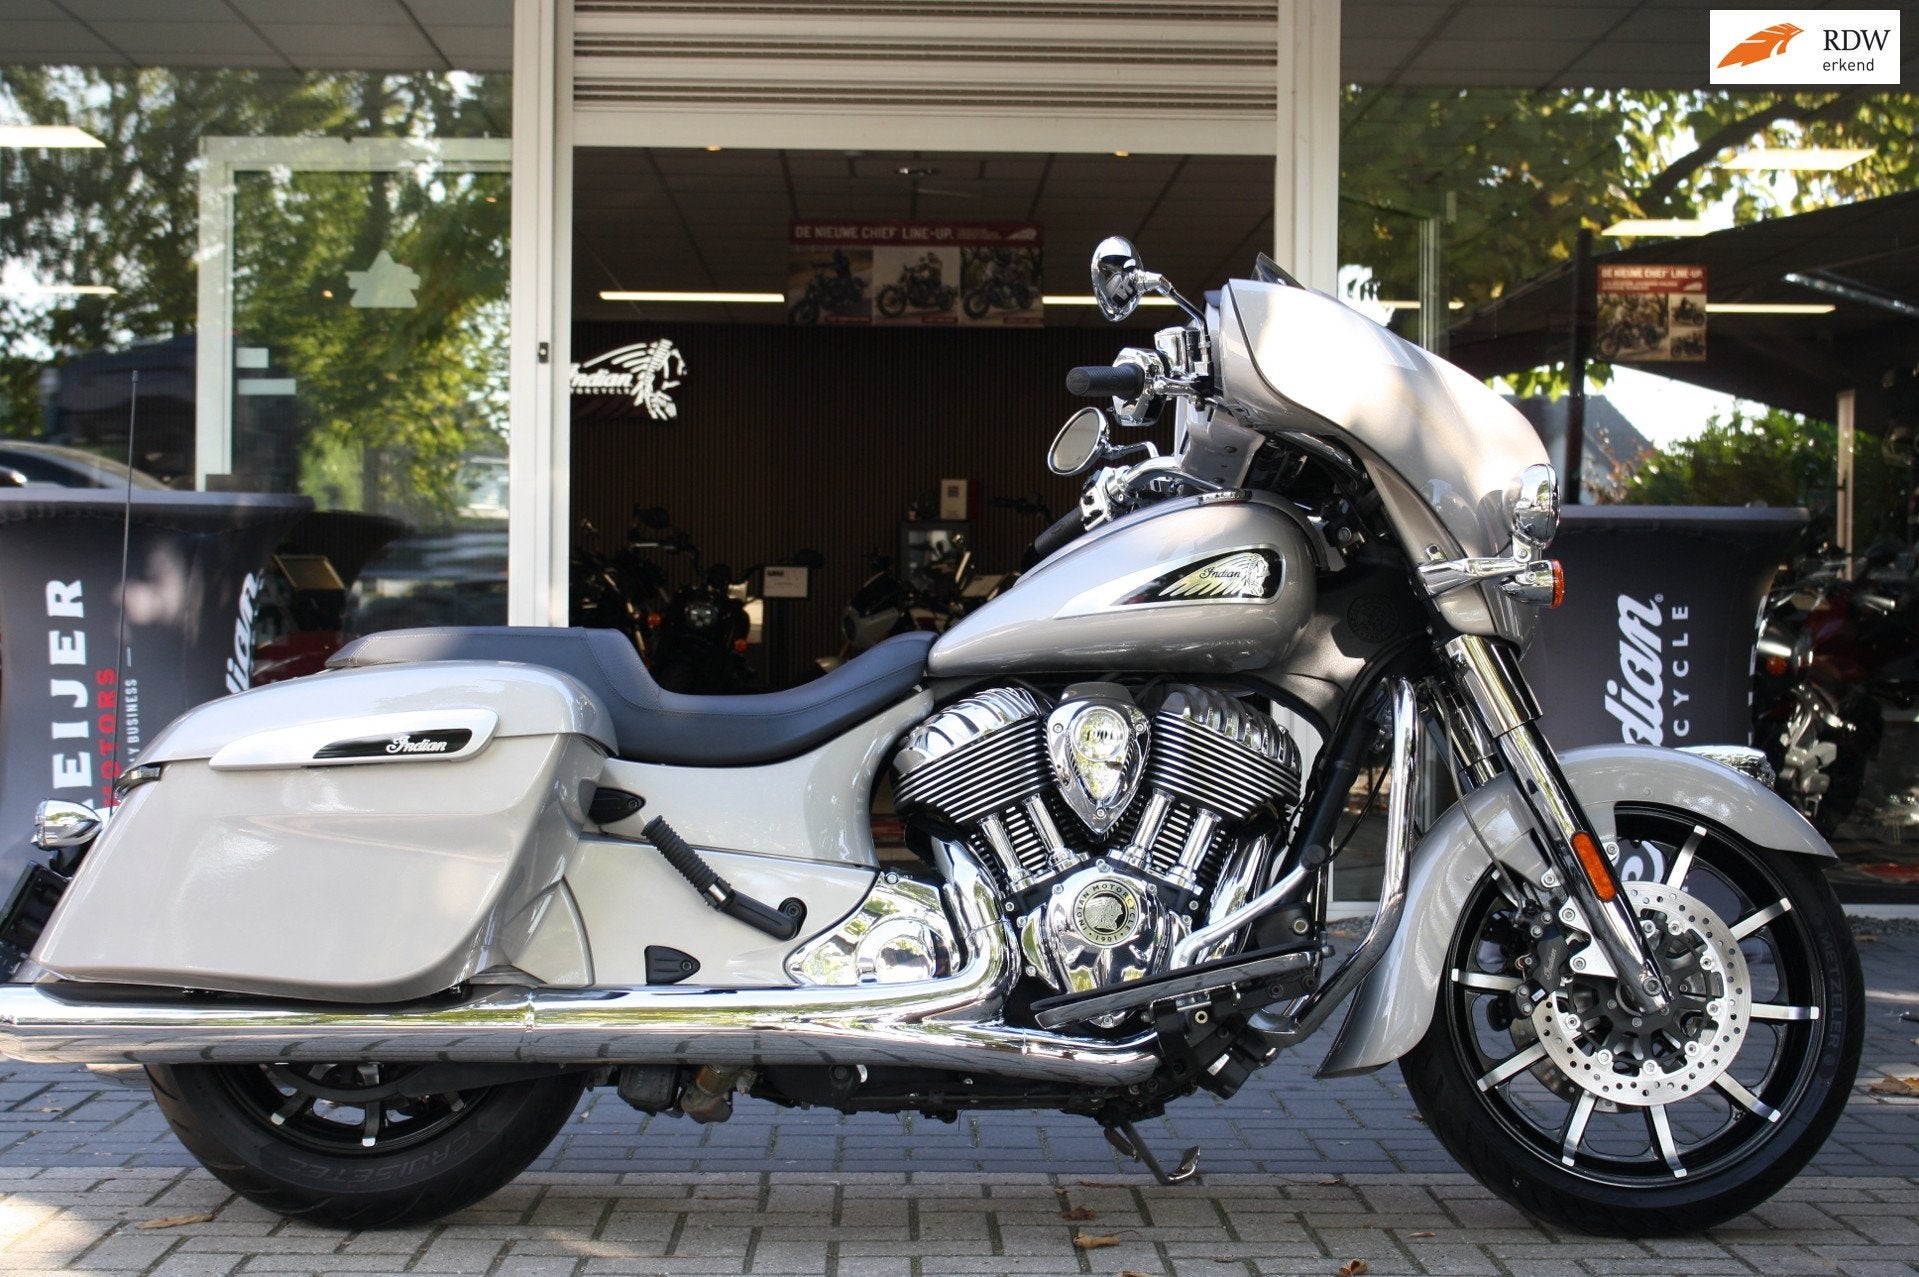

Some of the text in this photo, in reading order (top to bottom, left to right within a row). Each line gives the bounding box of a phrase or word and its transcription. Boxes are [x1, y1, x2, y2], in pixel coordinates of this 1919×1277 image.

[795, 226, 812, 239] DE
[815, 226, 859, 239] NIEUWE
[862, 227, 897, 239] CHIEF
[1199, 567, 1242, 579] Indian
[1671, 606, 1690, 737] CYCLE
[45, 579, 94, 810] EIJER
[124, 678, 140, 744] BUSINESS
[386, 736, 448, 753] Indian
[1077, 883, 1136, 931] INDIAN MOTORCYCLE
[1543, 948, 1557, 980] Indian
